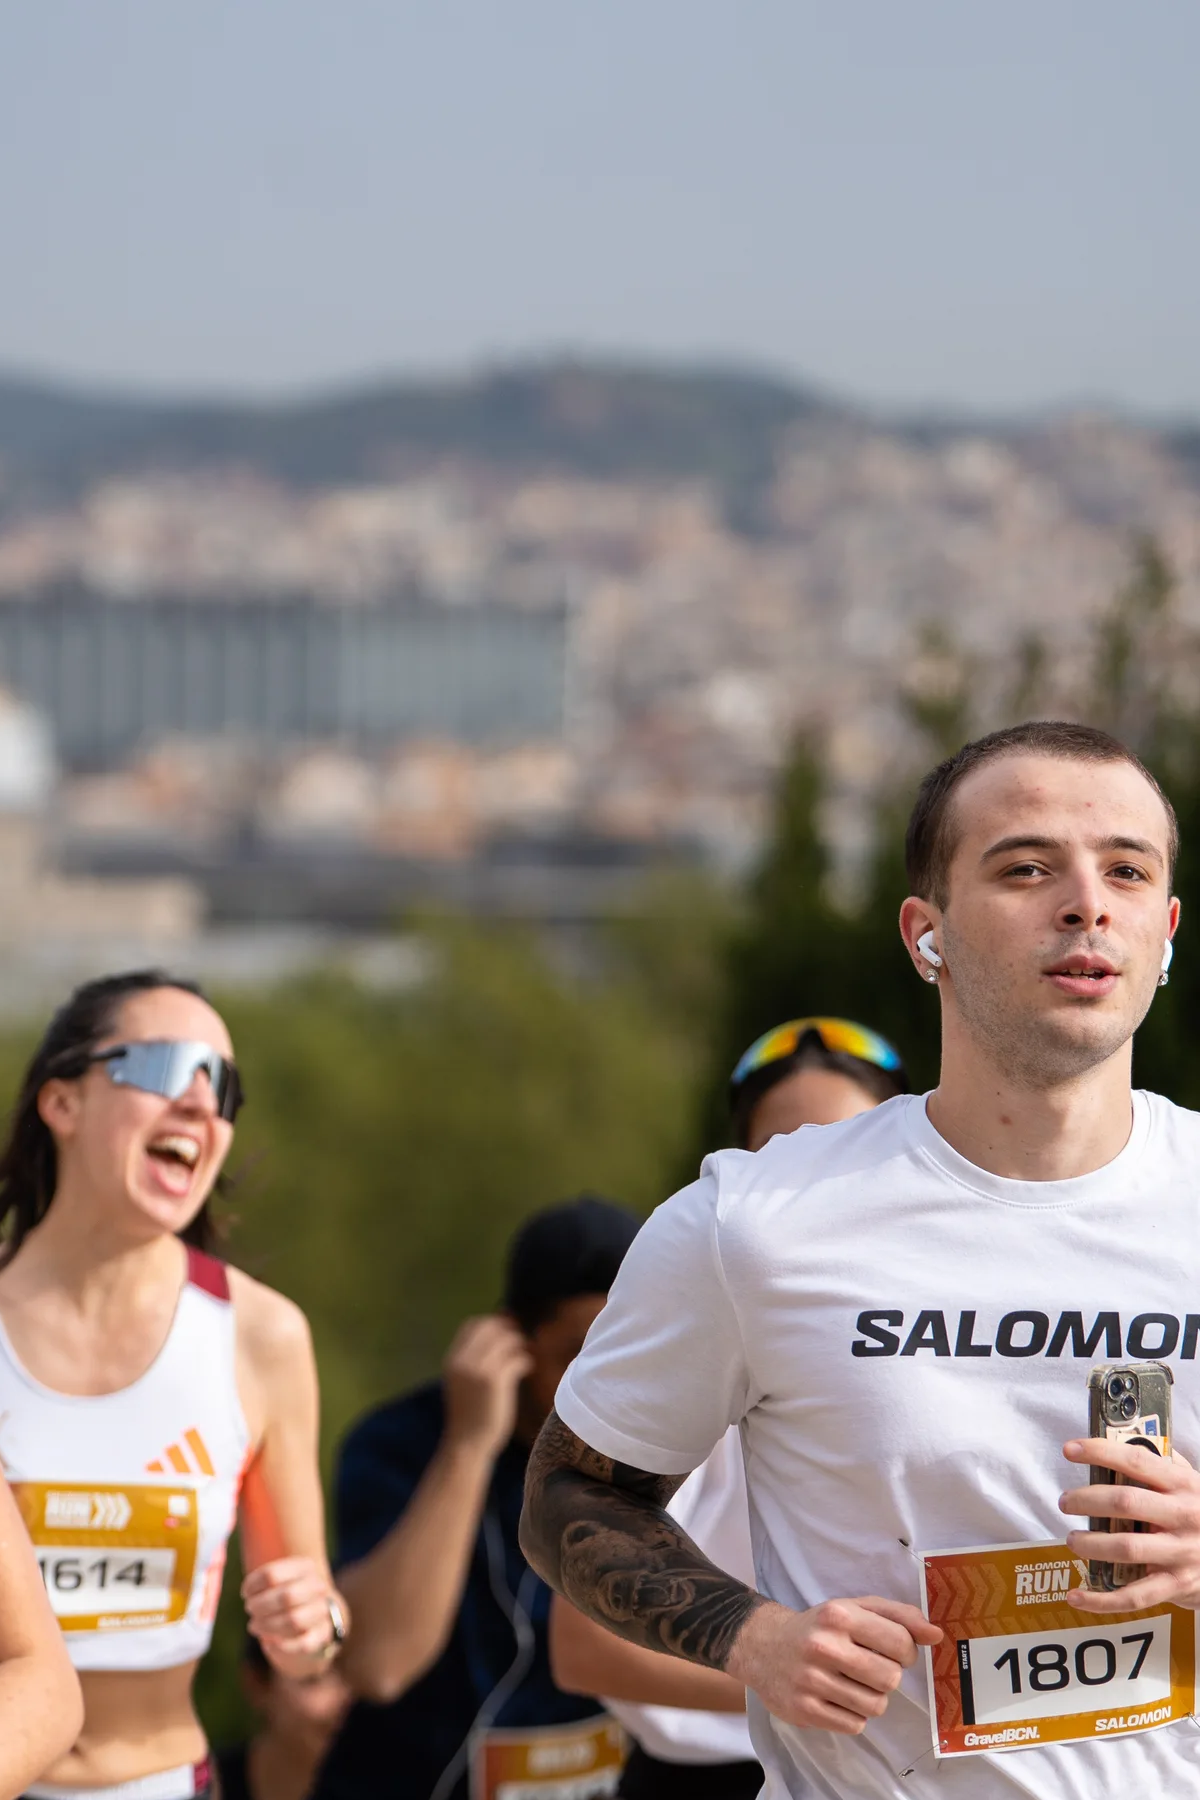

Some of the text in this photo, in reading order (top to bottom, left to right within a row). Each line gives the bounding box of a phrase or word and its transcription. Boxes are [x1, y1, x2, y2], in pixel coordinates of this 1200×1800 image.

[1014, 1560, 1070, 1573] SALOMON
[1015, 1569, 1071, 1595] RUN
[993, 1631, 1154, 1694] 1807
[1095, 1706, 1172, 1732] SALOMON
[964, 1726, 1041, 1747] GravelBCN.
